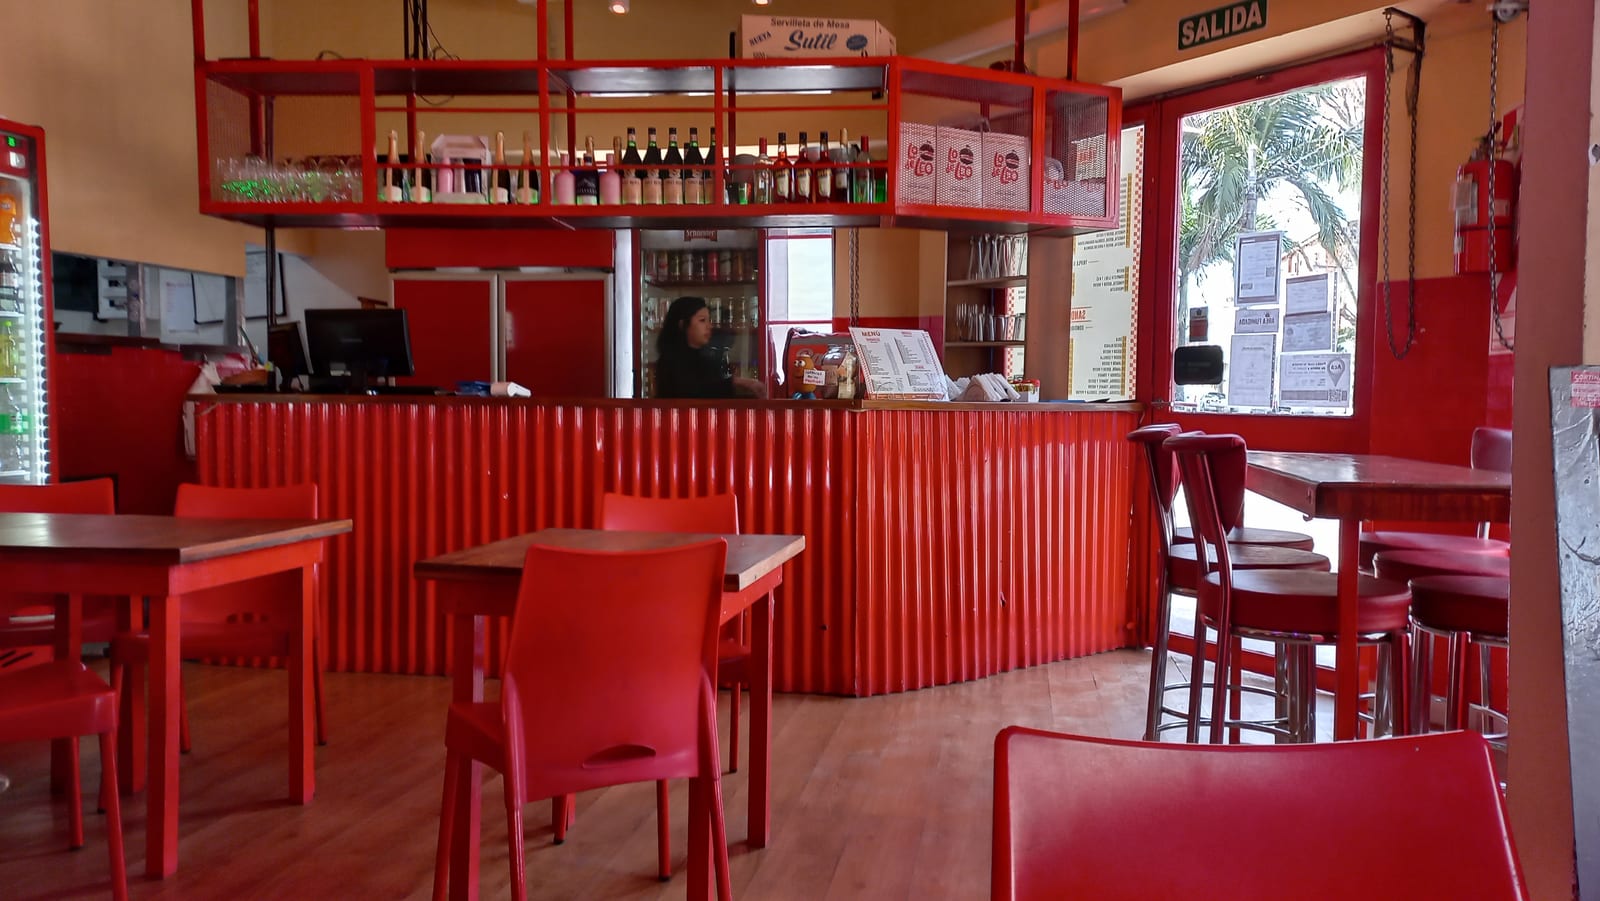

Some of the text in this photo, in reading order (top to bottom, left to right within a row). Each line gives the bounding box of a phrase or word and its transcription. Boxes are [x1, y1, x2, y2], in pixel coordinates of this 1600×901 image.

[770, 18, 850, 29] Servilleta de Mesa
[1181, 1, 1262, 46] SALIDA
[784, 29, 838, 51] Sutil
